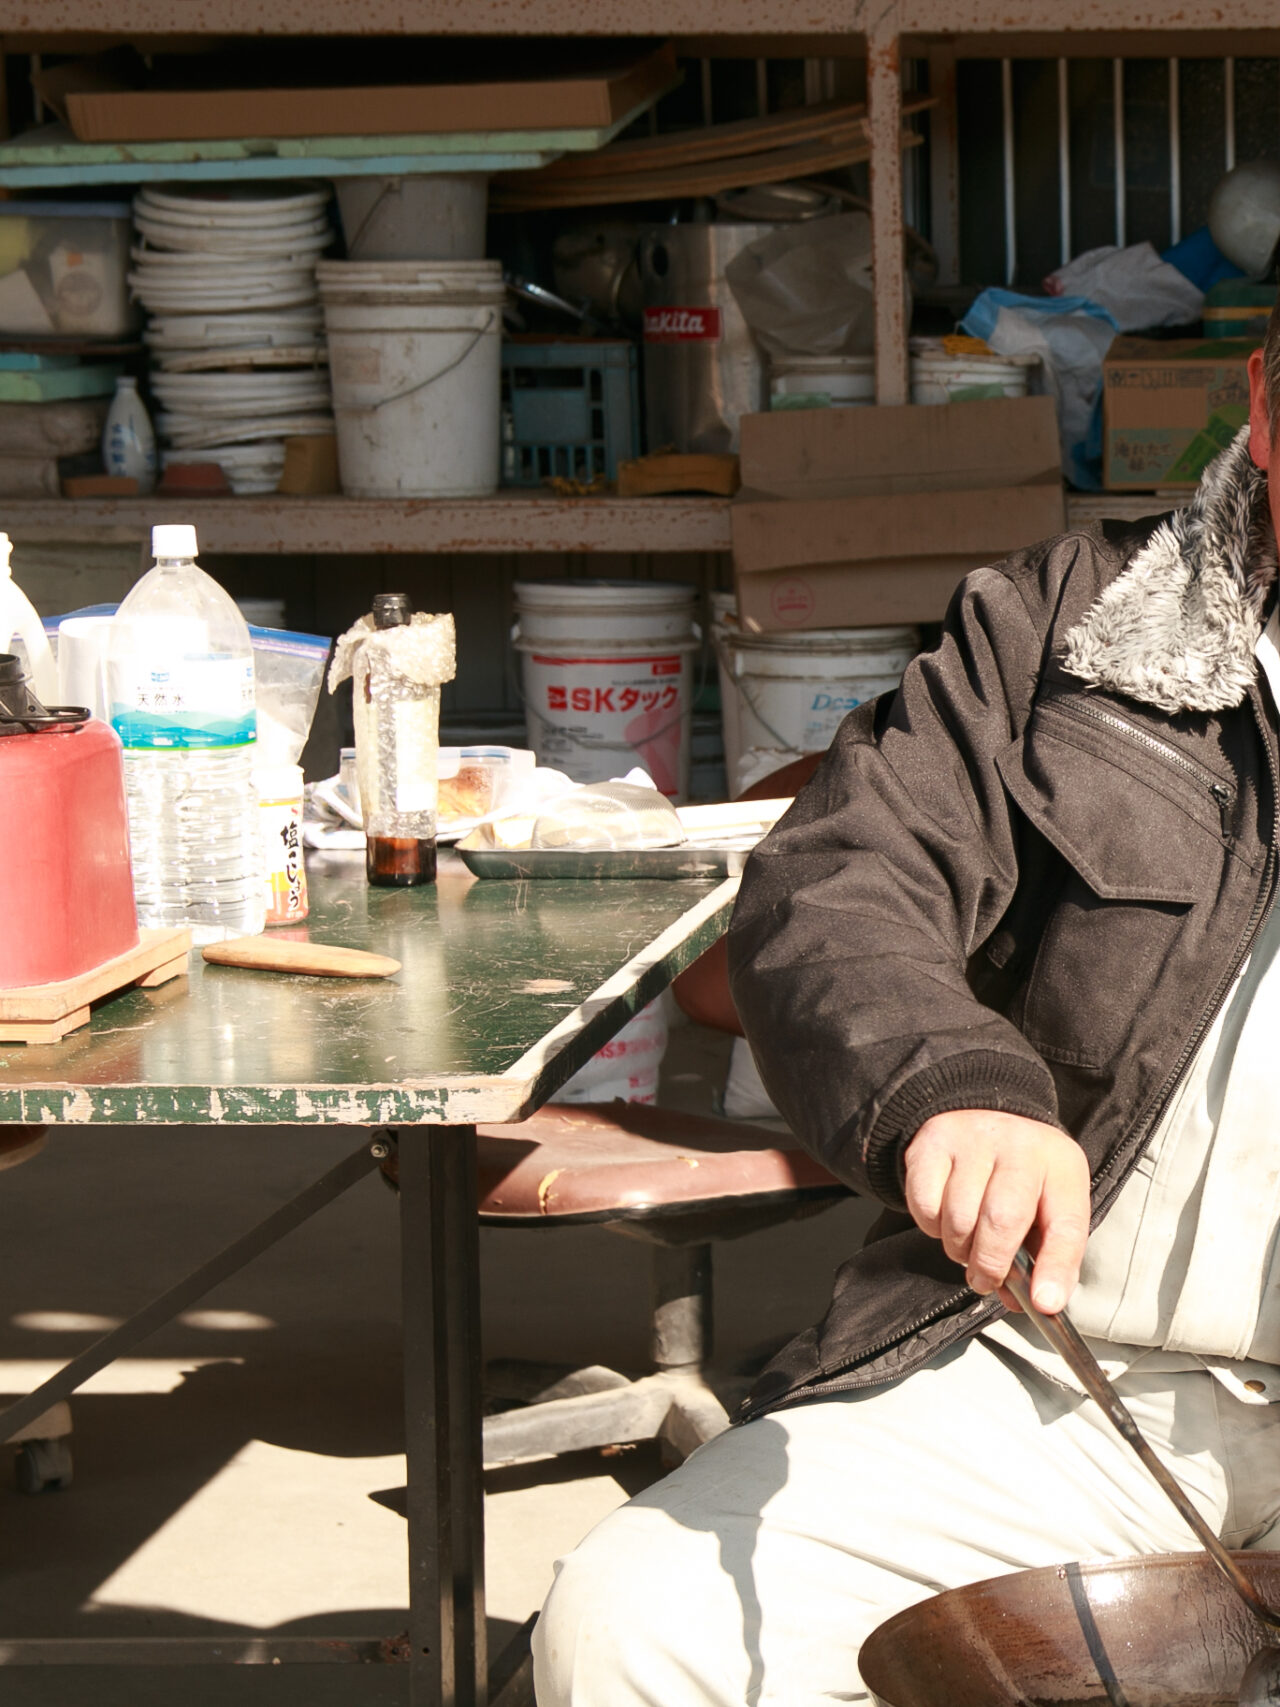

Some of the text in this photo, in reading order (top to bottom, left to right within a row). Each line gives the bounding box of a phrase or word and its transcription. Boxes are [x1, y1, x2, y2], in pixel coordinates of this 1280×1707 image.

[645, 311, 705, 333] akita
[136, 693, 185, 707] 天然水
[571, 685, 678, 713] SKタック
[280, 820, 299, 909] 塩こしょう
